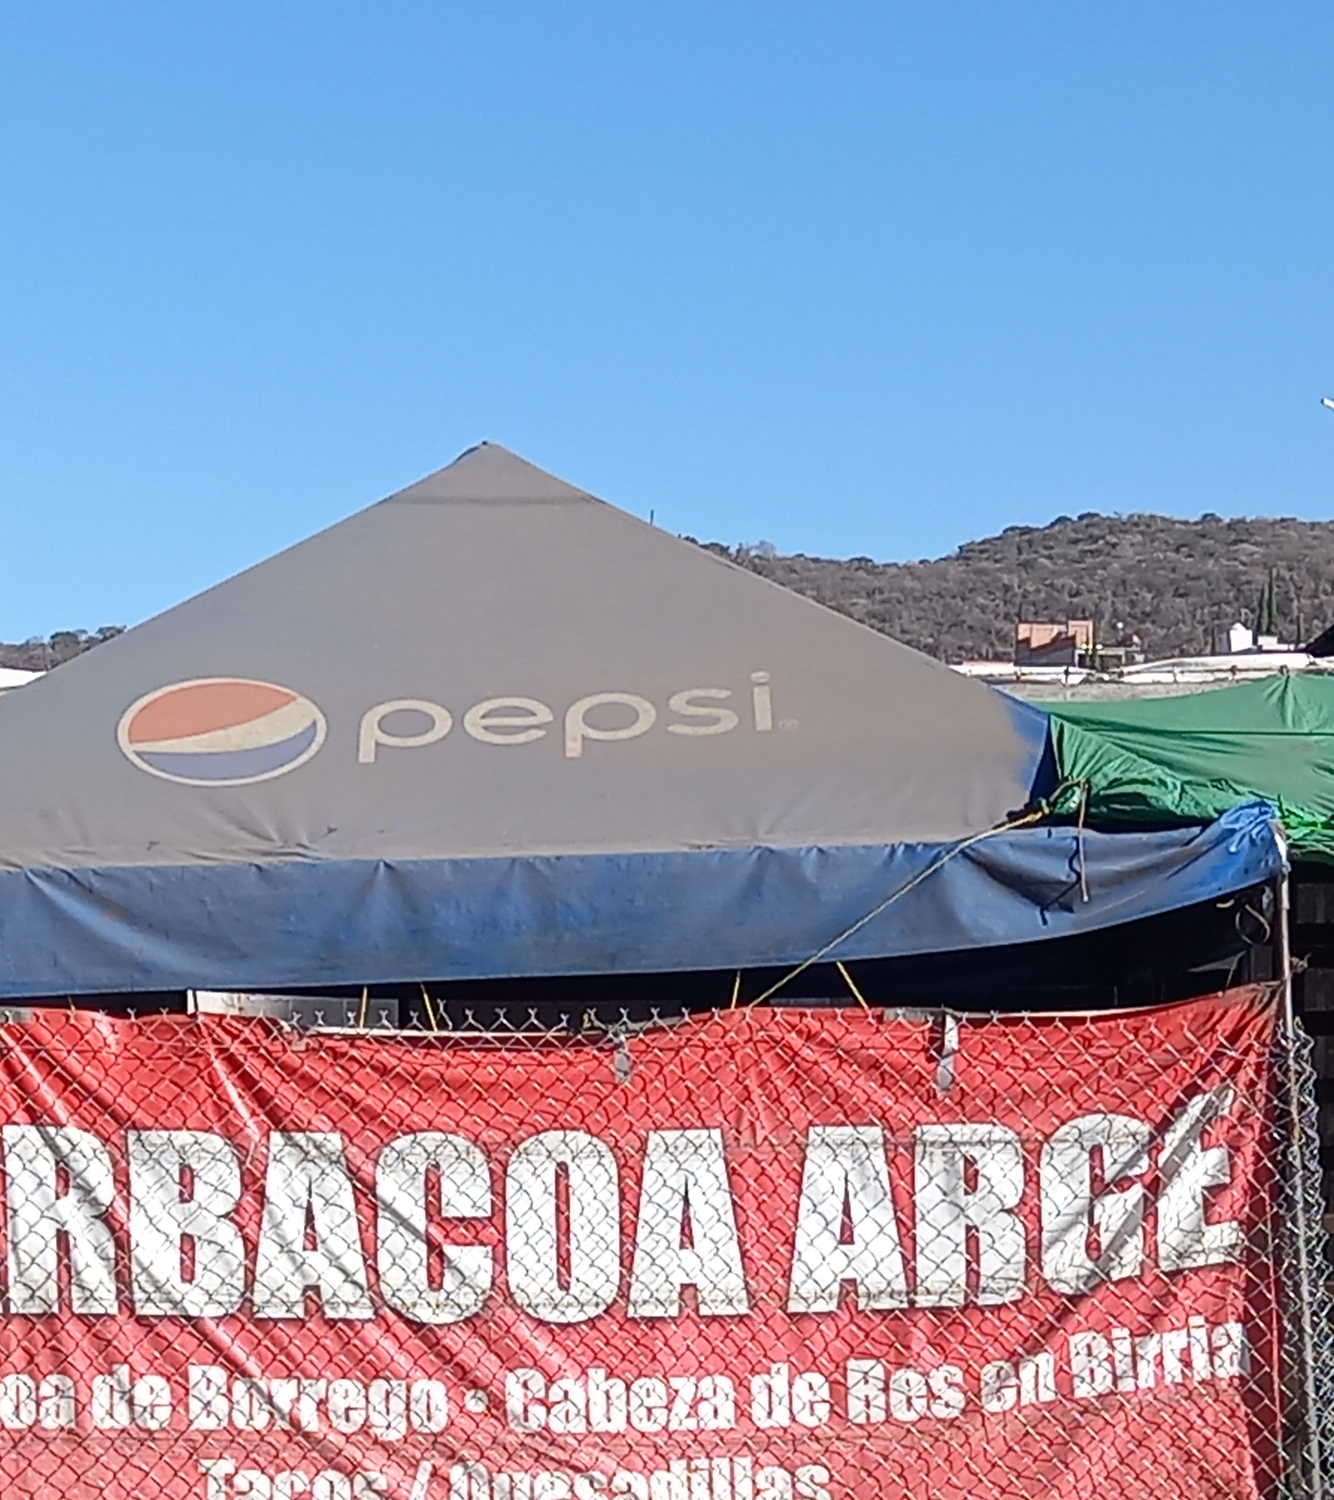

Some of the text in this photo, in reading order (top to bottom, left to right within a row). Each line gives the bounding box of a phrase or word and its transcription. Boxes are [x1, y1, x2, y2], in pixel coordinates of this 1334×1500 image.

[357, 670, 773, 764] pepsi
[91, 1363, 172, 1430] de
[187, 1364, 449, 1441] Borrego
[504, 1368, 735, 1433] Cabeza
[750, 1363, 831, 1428] de
[846, 1358, 965, 1424] Res
[980, 1352, 1057, 1413] en
[1069, 1316, 1250, 1398] Birria
